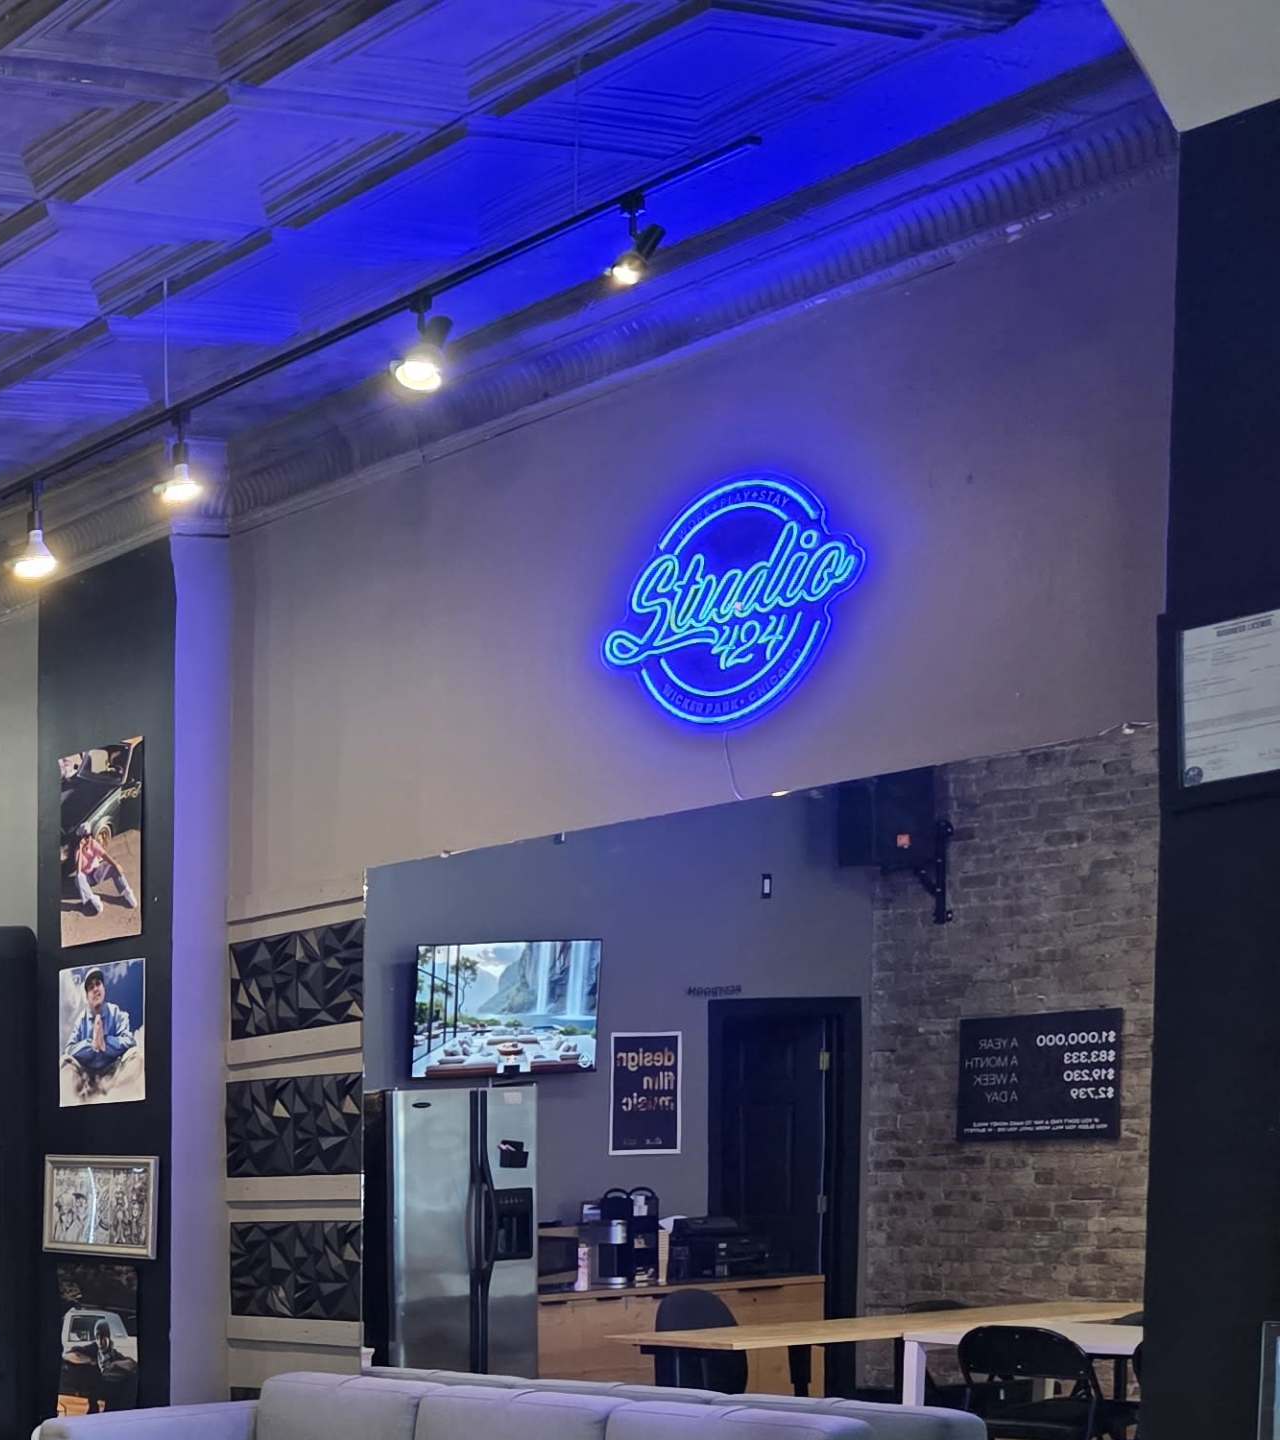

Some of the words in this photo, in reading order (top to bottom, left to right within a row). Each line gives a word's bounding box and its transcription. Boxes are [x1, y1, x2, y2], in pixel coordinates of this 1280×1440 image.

[759, 489, 790, 508] STAY
[605, 520, 855, 665] Studio
[711, 613, 788, 670] 424
[662, 683, 704, 713] WICKER
